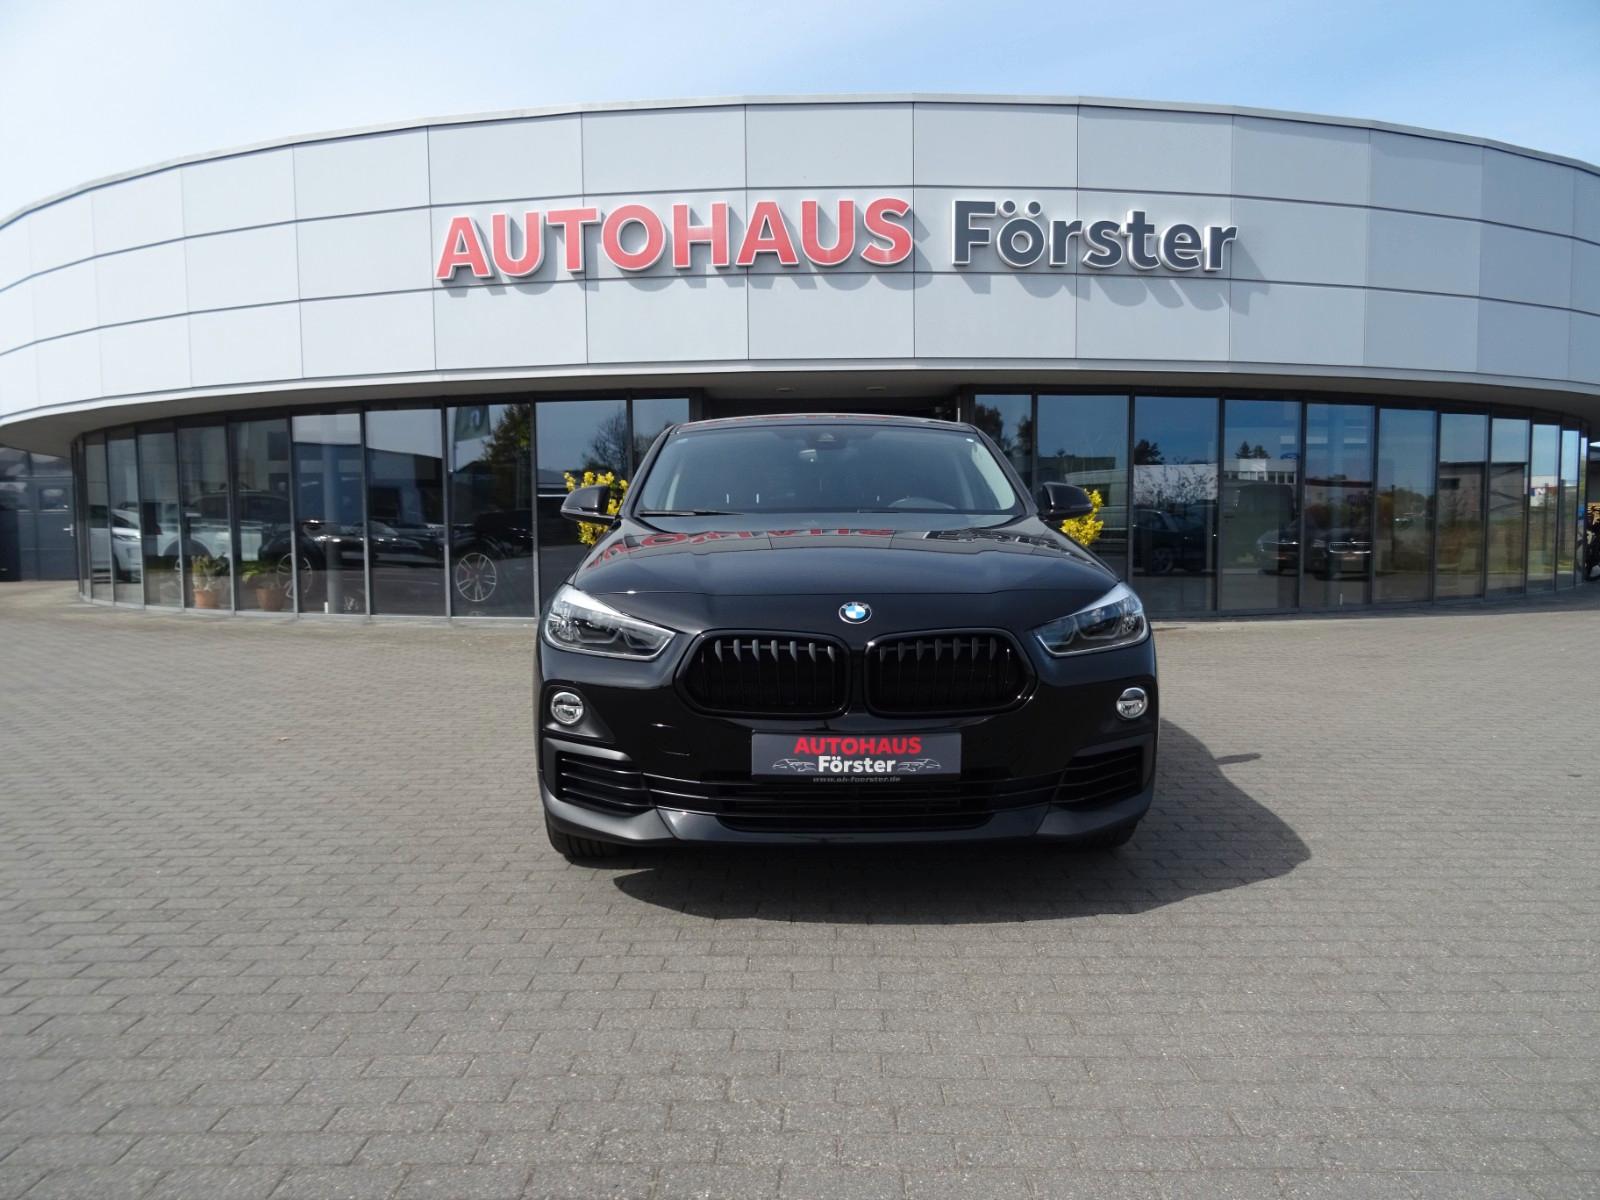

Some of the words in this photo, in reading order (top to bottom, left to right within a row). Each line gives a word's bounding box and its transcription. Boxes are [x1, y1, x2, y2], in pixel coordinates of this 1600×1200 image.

[434, 197, 915, 281] AUTOHAUS
[951, 199, 1238, 272] Förster
[794, 736, 923, 755] AUTOHAUS
[817, 755, 897, 773] Förster
